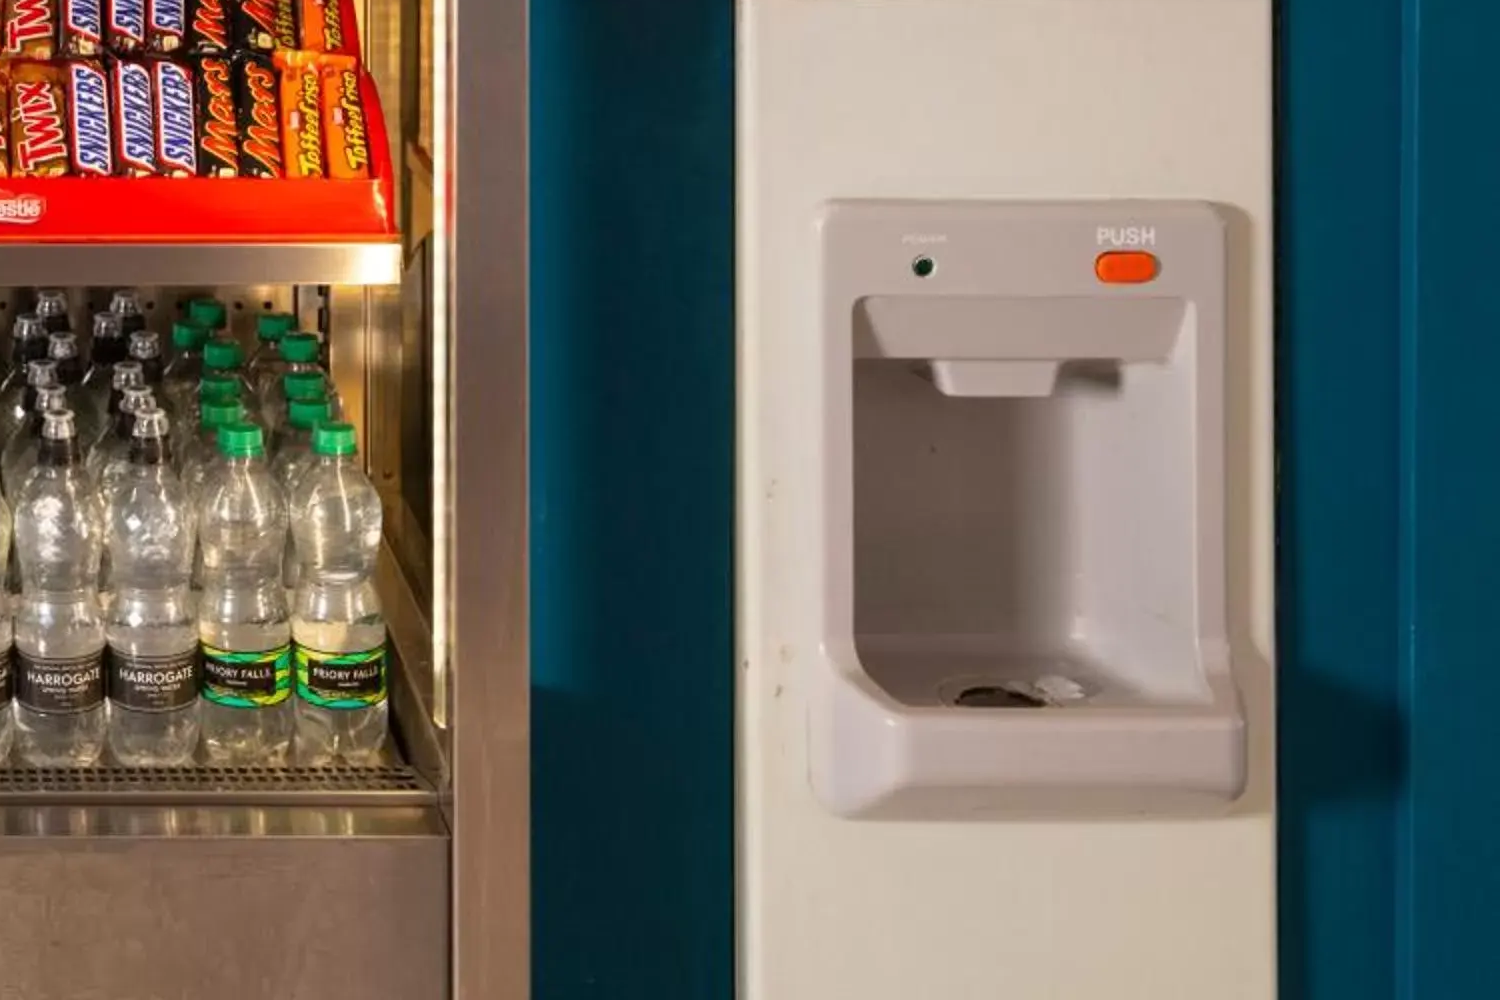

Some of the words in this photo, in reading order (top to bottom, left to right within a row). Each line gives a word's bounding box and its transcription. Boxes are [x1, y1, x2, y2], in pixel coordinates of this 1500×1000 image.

[18, 83, 67, 171] TWIX
[75, 68, 110, 172] SNICKERS
[121, 63, 155, 165] SNICKERS
[160, 64, 196, 171] SNICKERS
[200, 58, 239, 168] Mars
[244, 62, 283, 176] Mars
[1097, 226, 1156, 246] PUSH
[26, 668, 101, 687] HARROGATE
[119, 667, 194, 685] HARROGATE
[240, 667, 272, 679] FALLS
